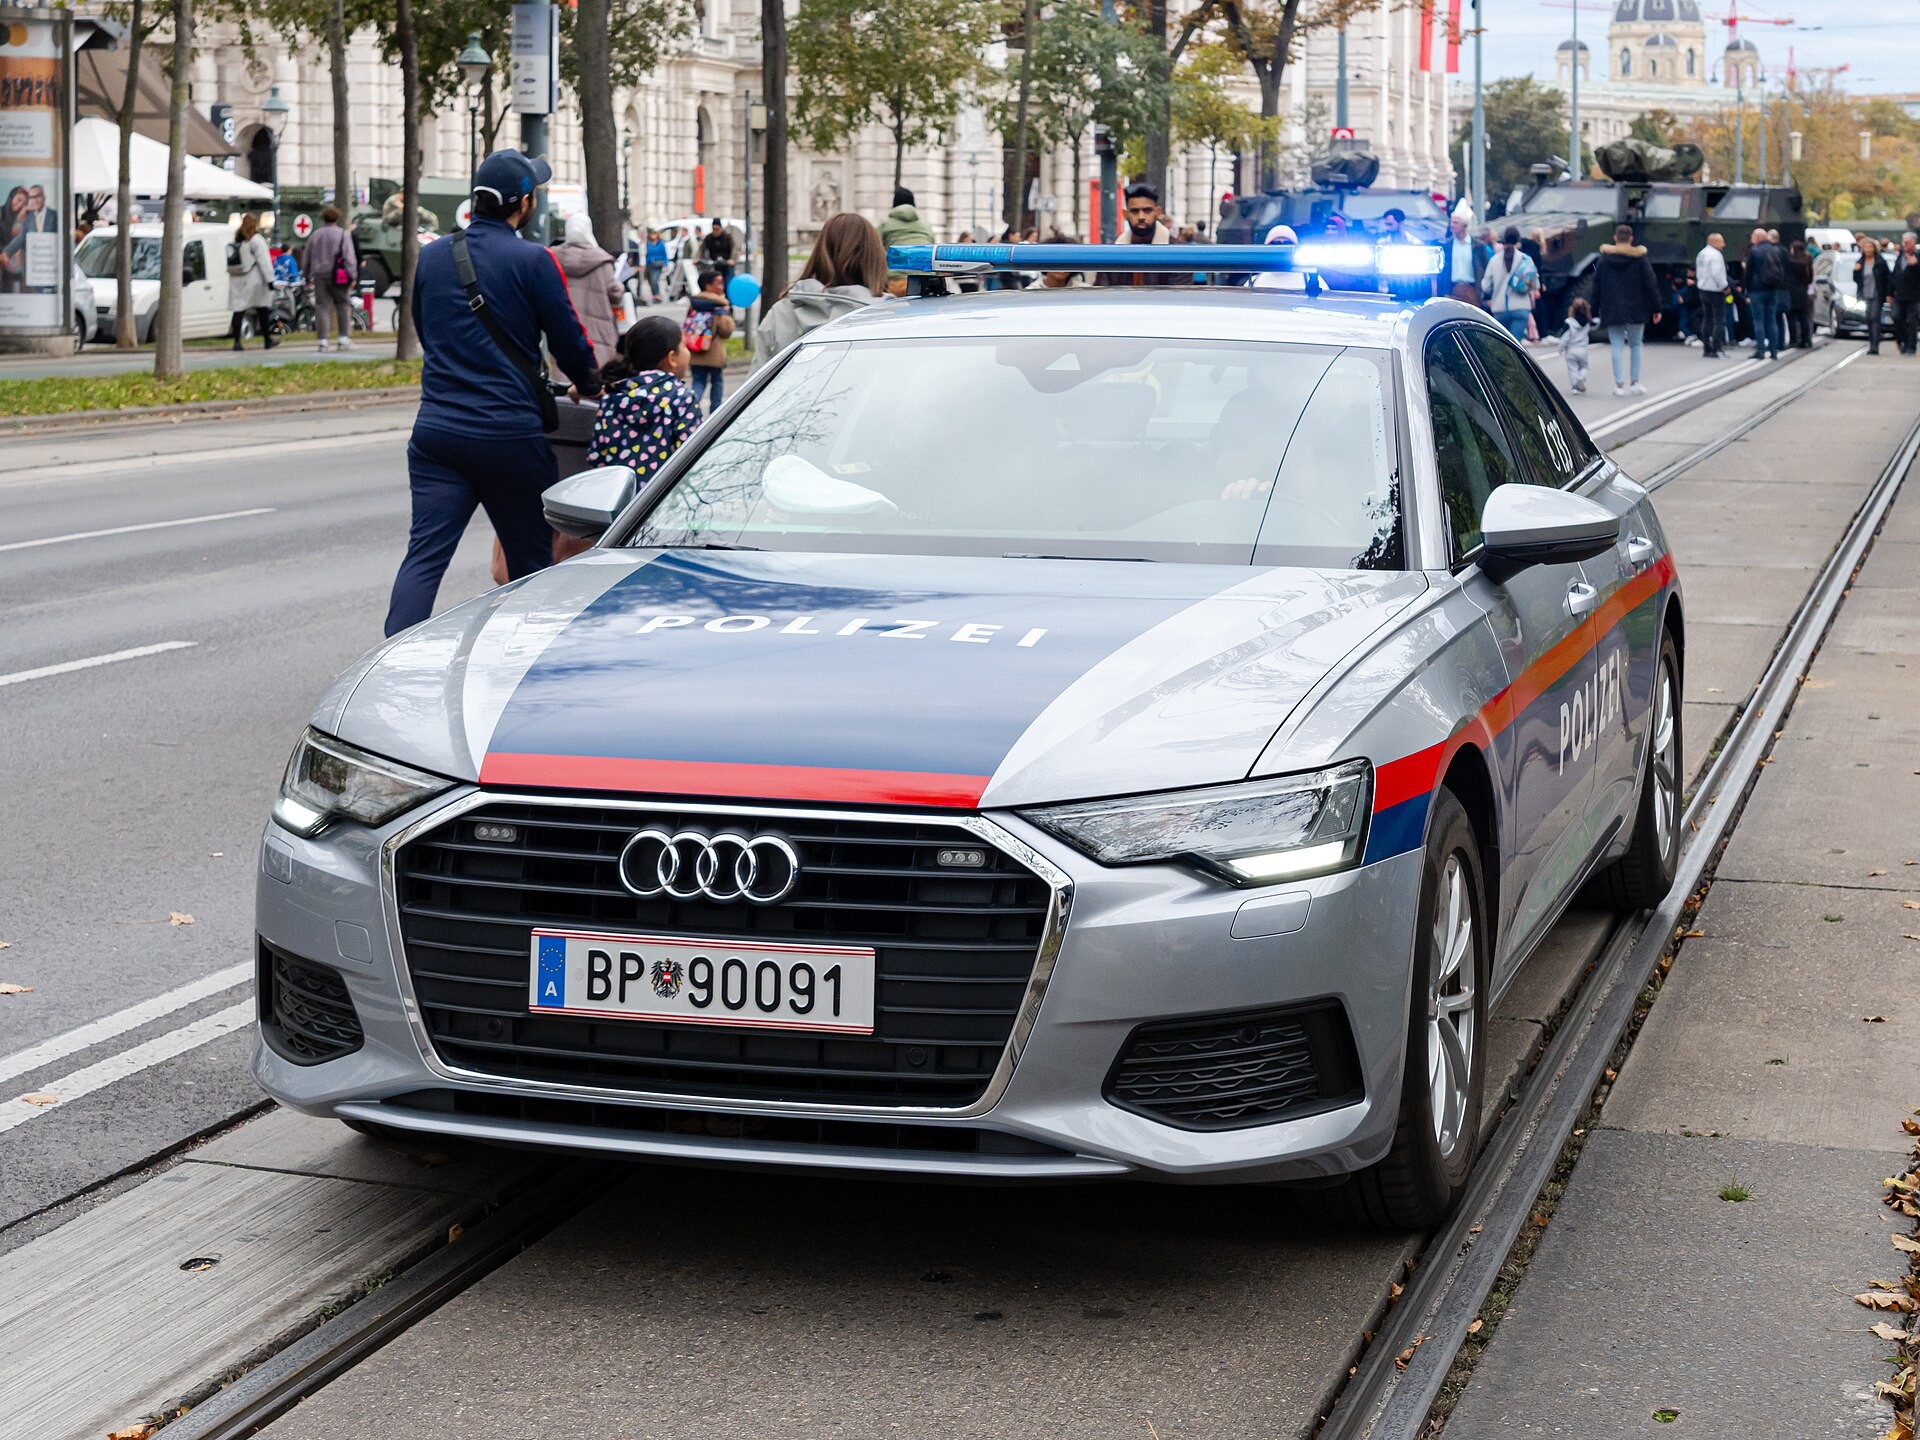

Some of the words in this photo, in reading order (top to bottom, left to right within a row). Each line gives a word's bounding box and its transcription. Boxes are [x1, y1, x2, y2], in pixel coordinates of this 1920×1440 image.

[635, 615, 1049, 647] POLIZEI
[1559, 648, 1620, 777] POLIZEI
[544, 981, 558, 997] A
[587, 949, 645, 1003] BP
[688, 956, 842, 1017] 90091
